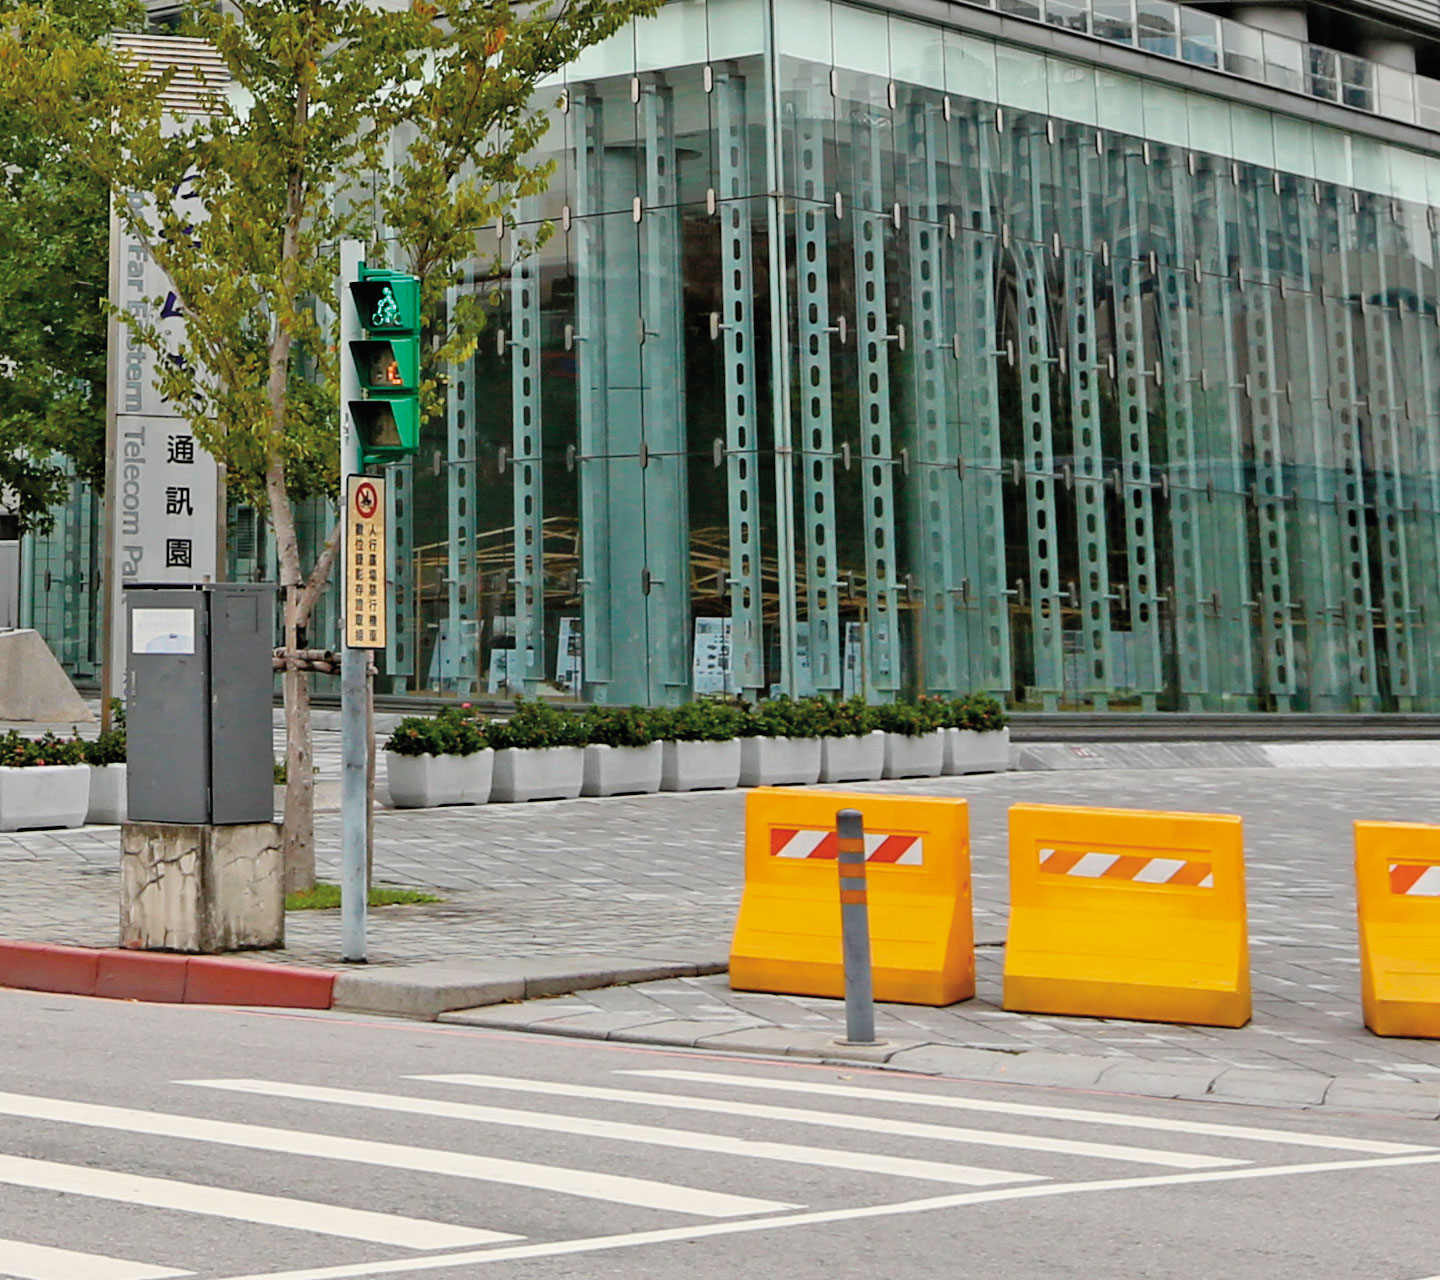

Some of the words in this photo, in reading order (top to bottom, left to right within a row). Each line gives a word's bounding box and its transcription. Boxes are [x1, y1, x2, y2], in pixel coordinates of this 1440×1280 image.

[127, 244, 148, 292] Far
[125, 300, 148, 412] Estern
[122, 426, 145, 535] Telecom
